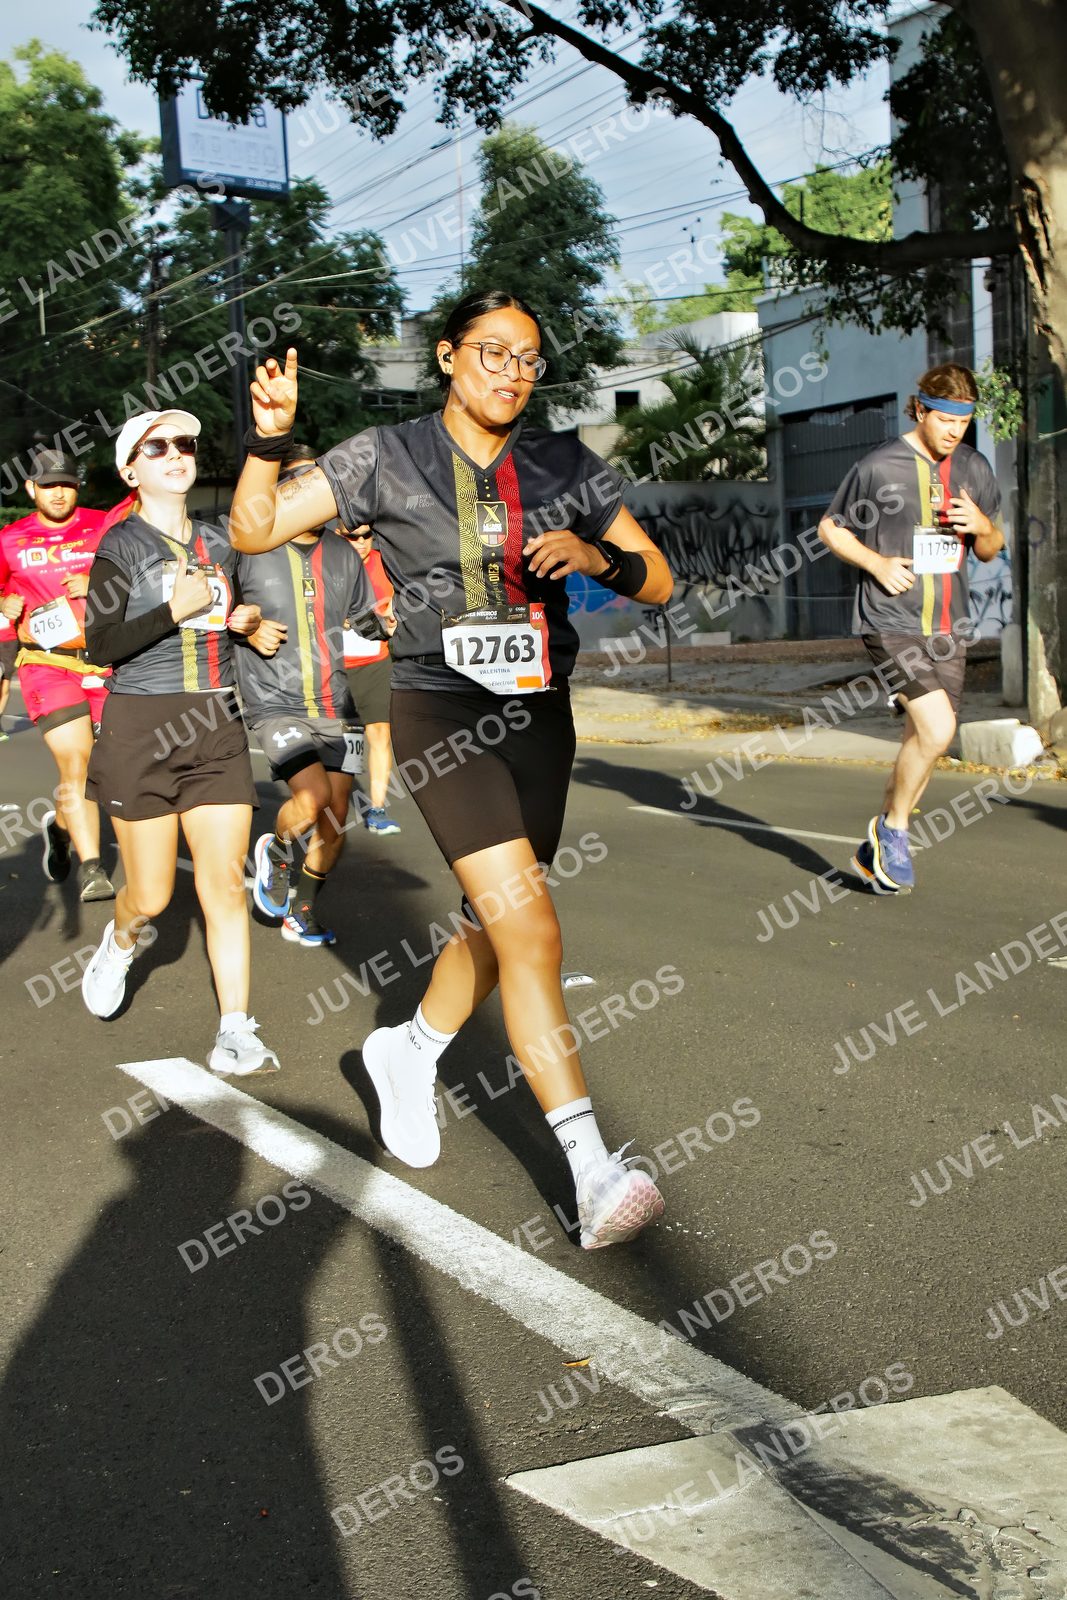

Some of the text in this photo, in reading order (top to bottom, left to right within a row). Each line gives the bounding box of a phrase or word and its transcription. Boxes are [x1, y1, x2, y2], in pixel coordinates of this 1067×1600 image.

[17, 544, 61, 569] 10K
[919, 541, 958, 556] 11799
[34, 615, 63, 635] 4765
[531, 611, 544, 620] 10K
[449, 634, 536, 666] 12763
